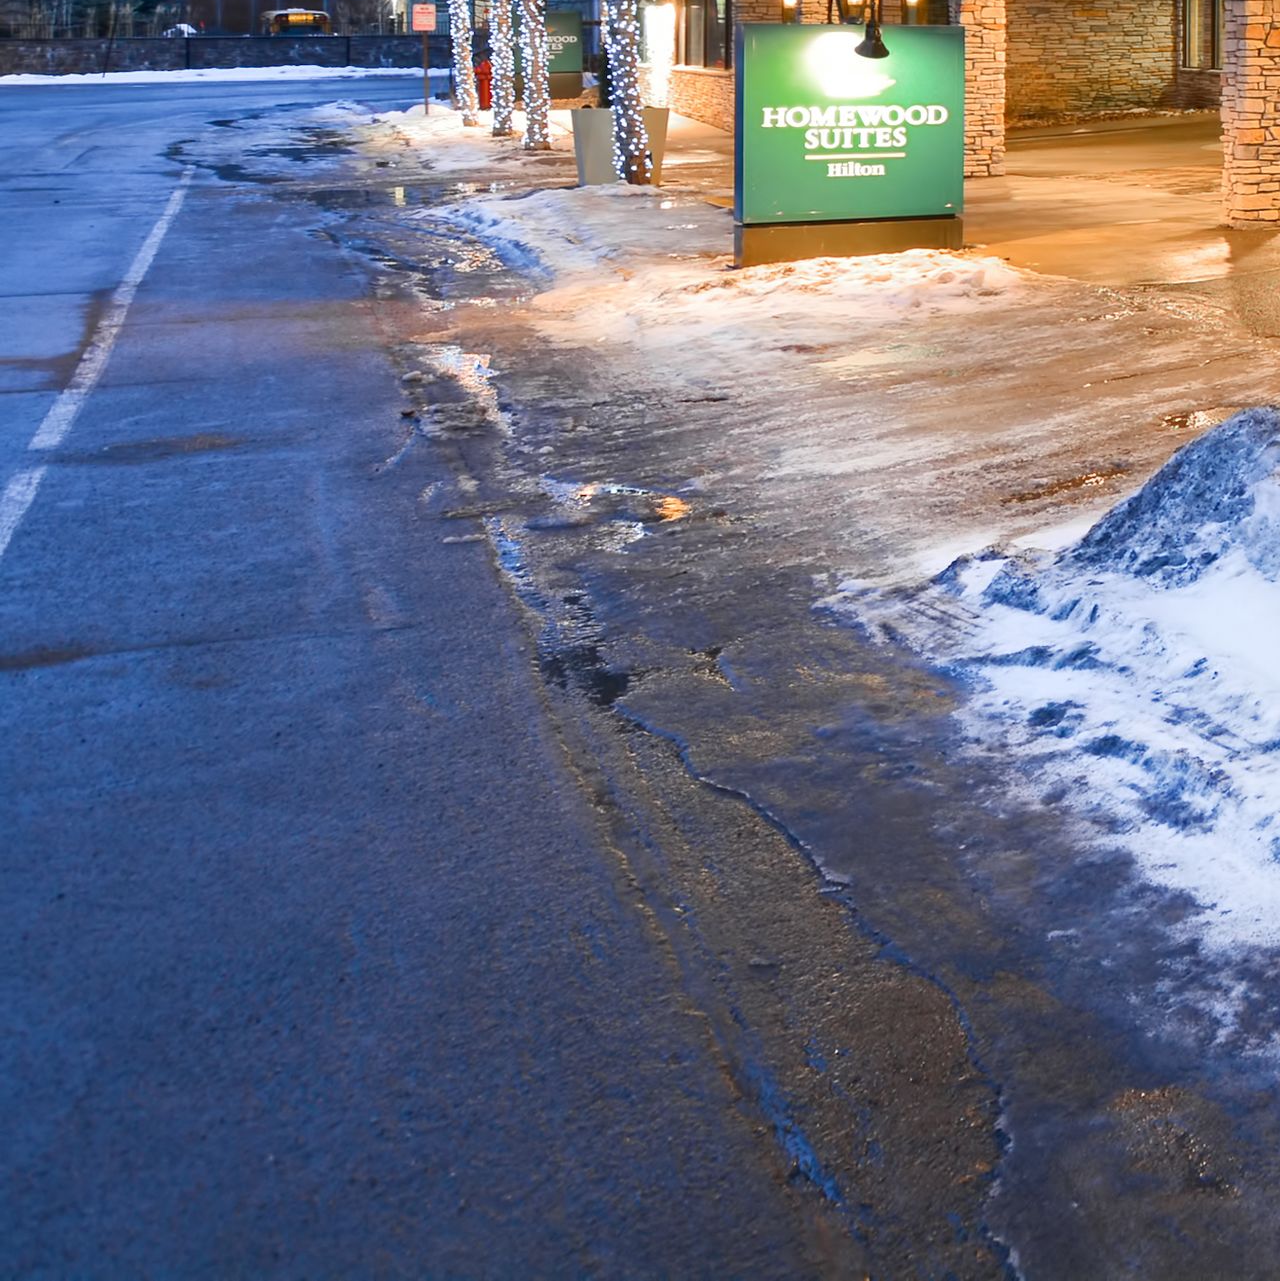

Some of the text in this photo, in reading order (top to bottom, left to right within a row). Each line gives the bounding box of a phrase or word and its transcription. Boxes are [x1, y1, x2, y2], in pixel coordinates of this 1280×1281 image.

[761, 104, 948, 128] HOMEWOOD
[804, 127, 907, 149] SUITES
[827, 161, 885, 177] Hilton
